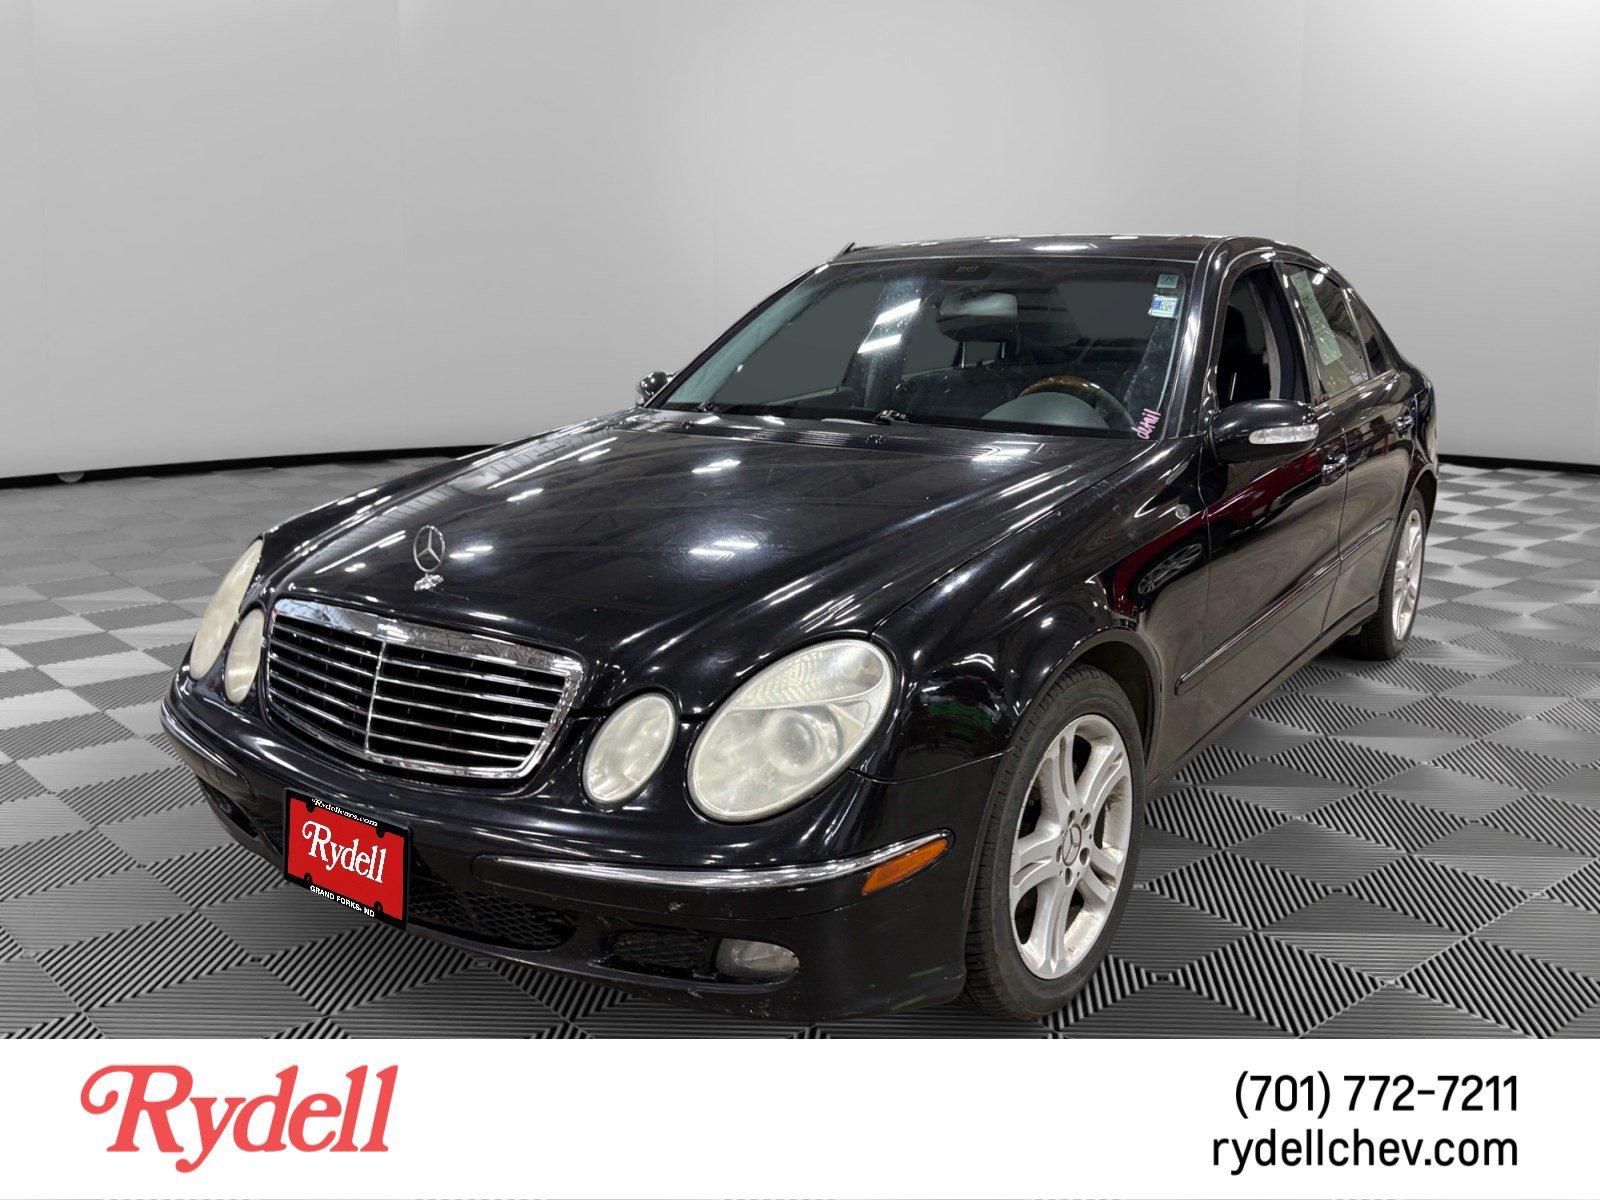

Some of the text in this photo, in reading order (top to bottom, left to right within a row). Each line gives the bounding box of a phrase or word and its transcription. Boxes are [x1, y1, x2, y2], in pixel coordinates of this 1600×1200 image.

[301, 820, 387, 884] Rydell
[310, 885, 335, 900] GRAND
[363, 907, 375, 918] ND
